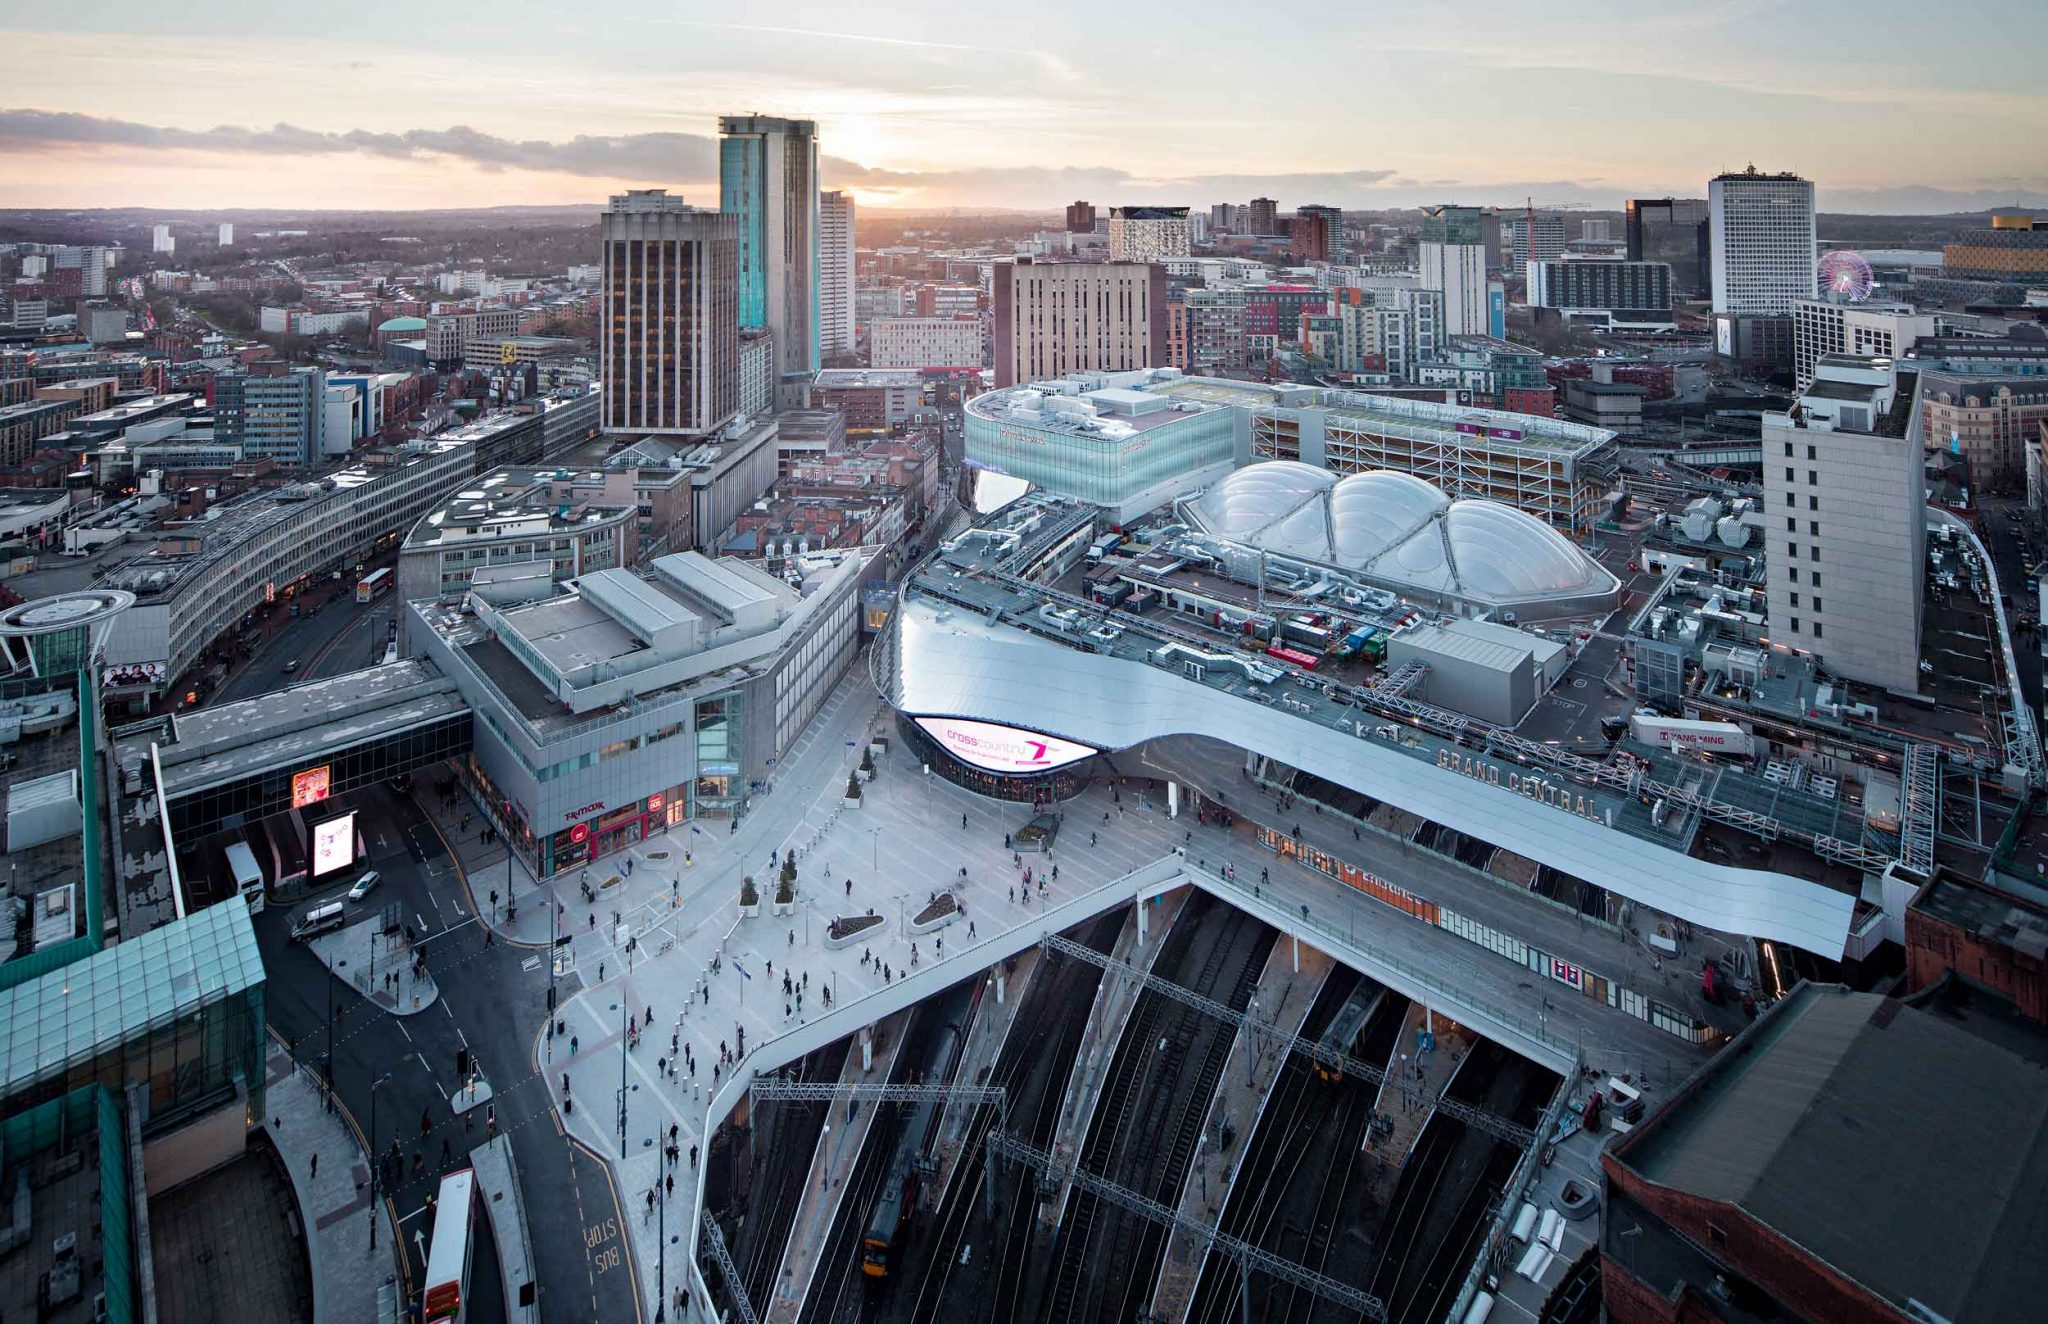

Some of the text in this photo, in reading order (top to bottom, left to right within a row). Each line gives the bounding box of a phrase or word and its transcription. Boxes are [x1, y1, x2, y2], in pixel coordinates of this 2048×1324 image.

[503, 346, 515, 359] £4
[1552, 698, 1576, 709] STOP
[1670, 733, 1725, 745] YANG MING
[1437, 748, 1600, 822] GRAND CENTRAL
[588, 1218, 617, 1248] STOP
[595, 1246, 620, 1274] BUS
